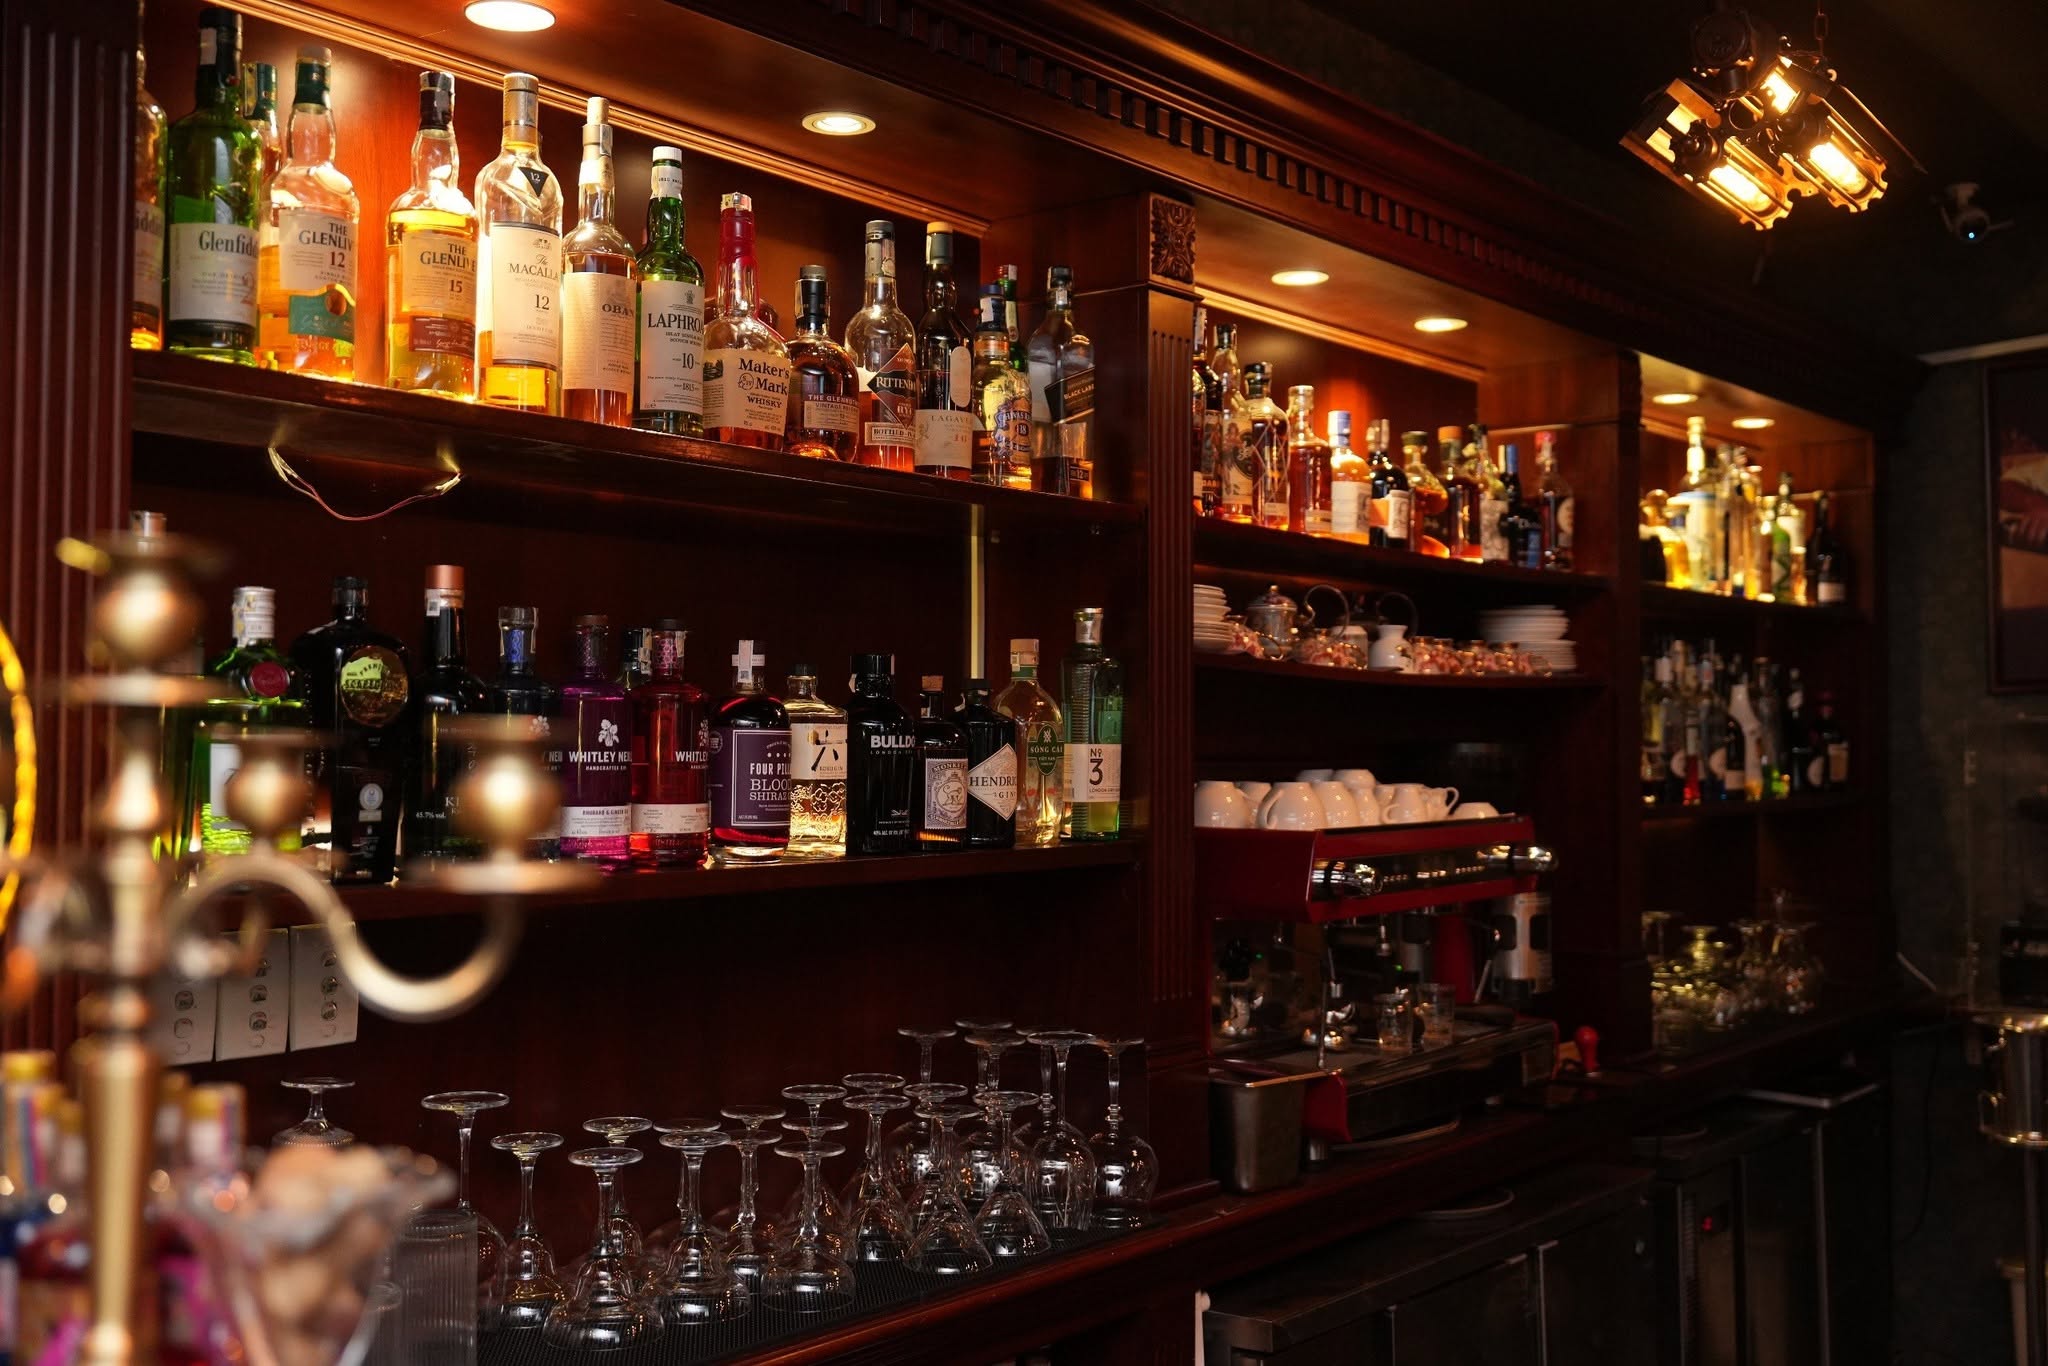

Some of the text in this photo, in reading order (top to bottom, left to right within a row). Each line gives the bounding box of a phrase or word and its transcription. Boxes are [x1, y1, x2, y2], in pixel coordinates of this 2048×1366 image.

[329, 222, 348, 236] THE
[448, 243, 467, 256] THE
[330, 251, 345, 268] 12
[449, 279, 464, 293] 15
[535, 294, 549, 310] 12
[682, 353, 694, 369] 10
[739, 358, 790, 379] Maker's
[755, 376, 787, 395] Mark
[747, 395, 782, 409] WHISKY
[568, 751, 616, 763] WHITLEY
[750, 762, 774, 775] FOUR
[1089, 758, 1104, 786] 3
